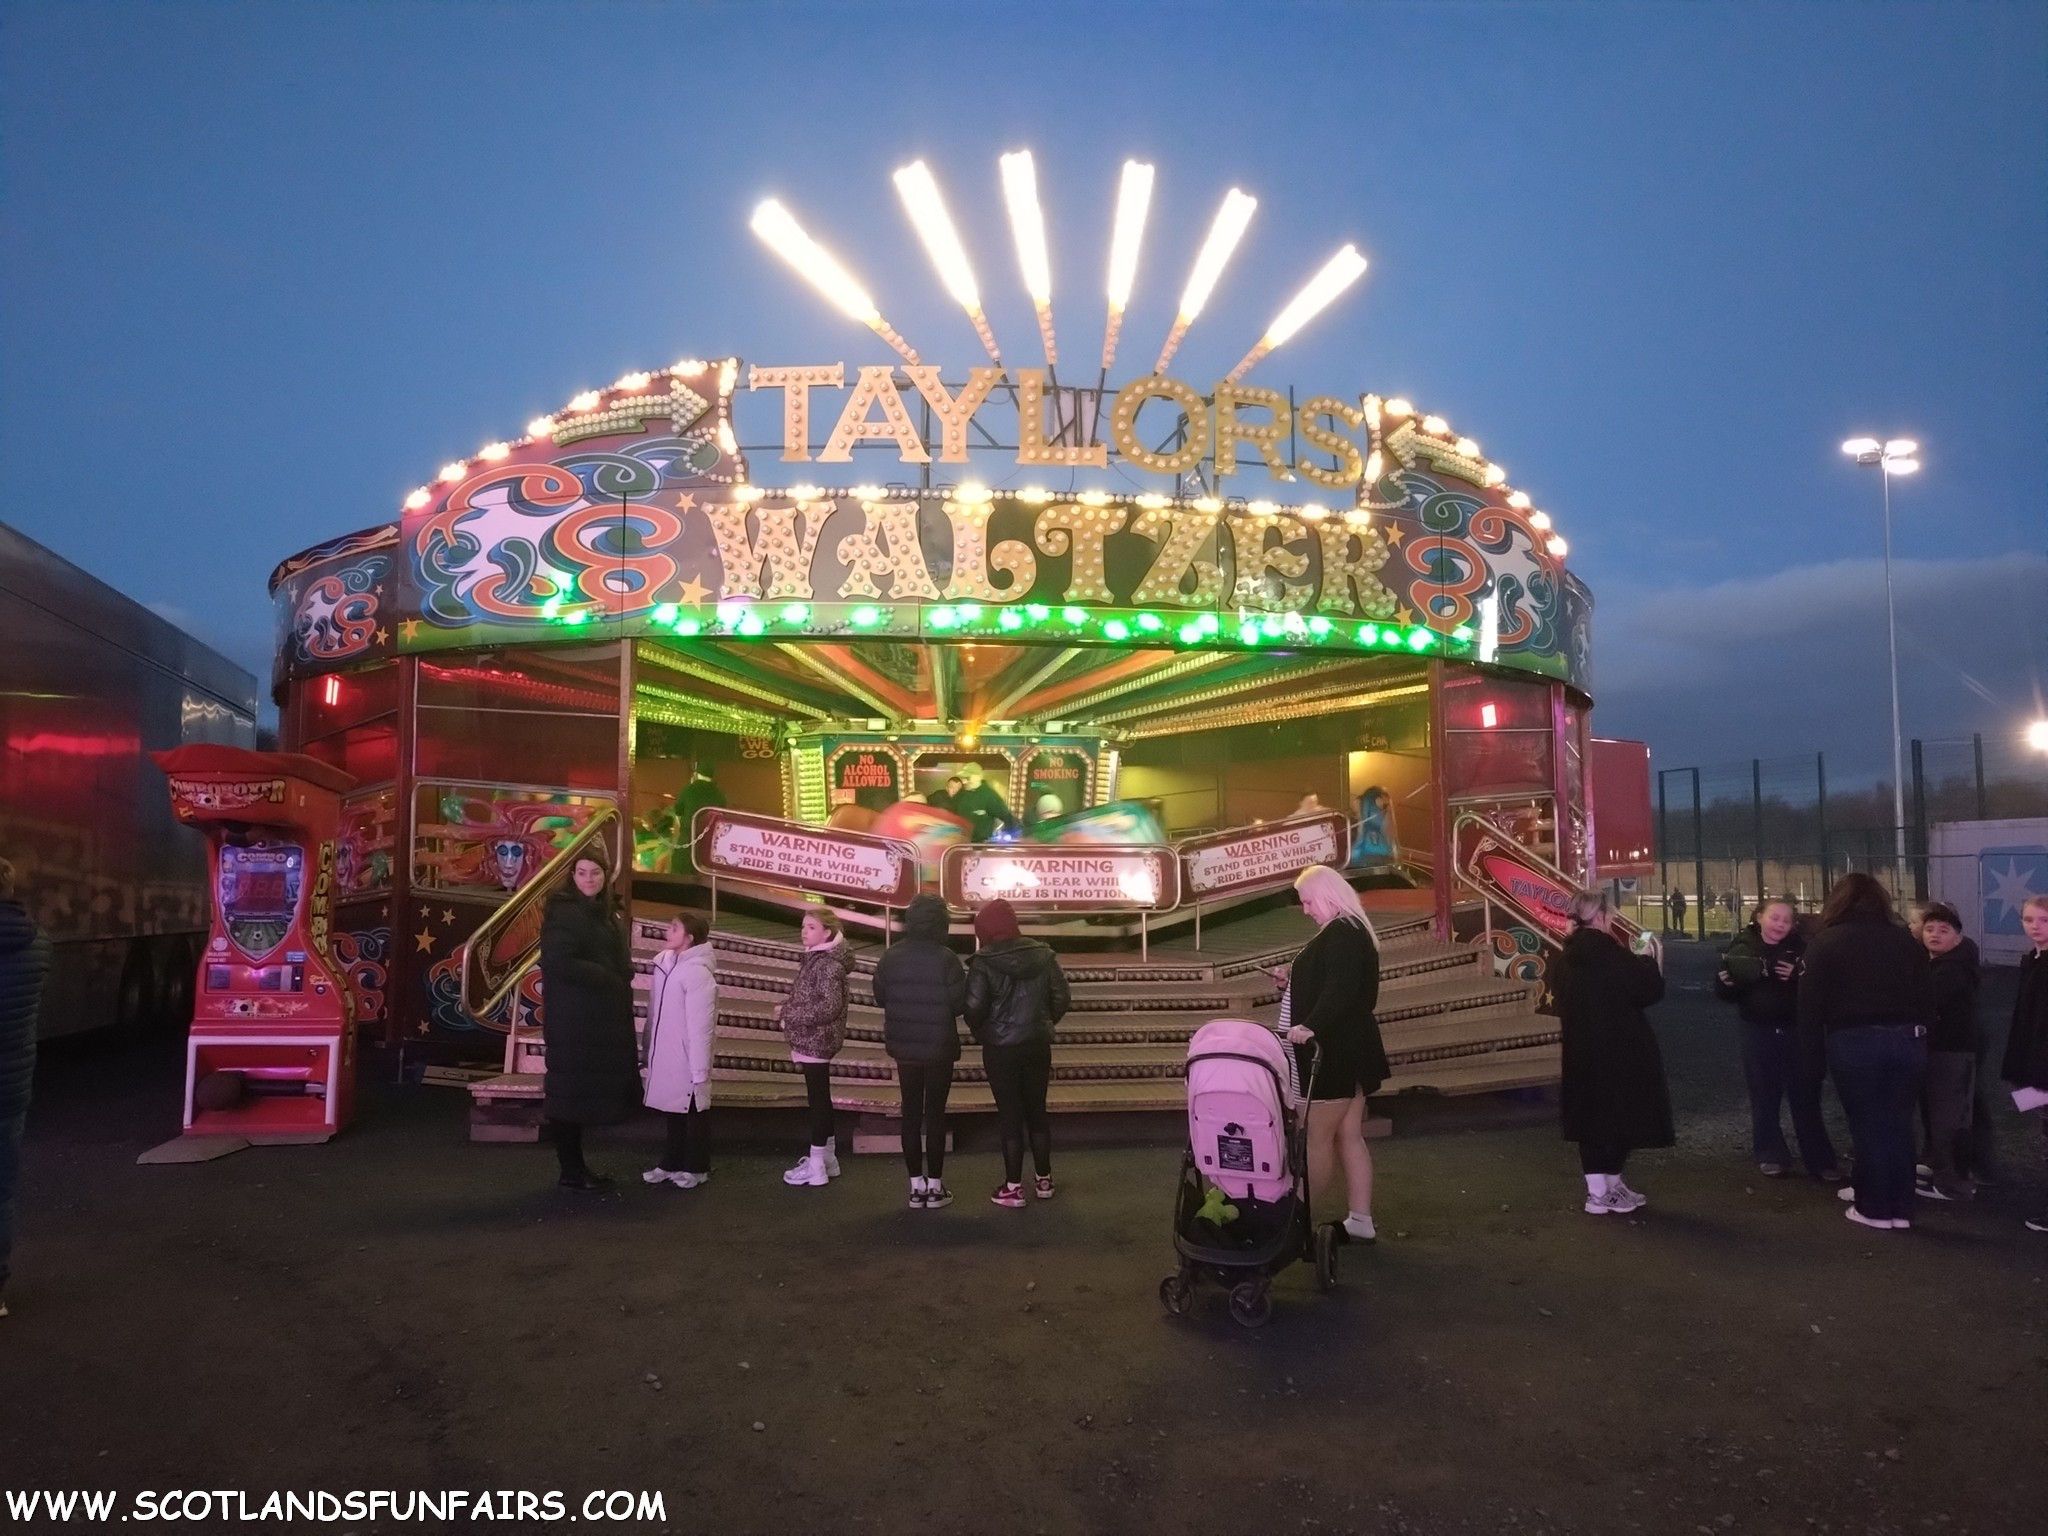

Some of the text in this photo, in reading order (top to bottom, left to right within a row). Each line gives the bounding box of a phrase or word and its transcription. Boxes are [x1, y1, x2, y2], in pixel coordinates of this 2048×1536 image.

[748, 364, 1365, 490] TAYLORS
[702, 500, 1398, 620] WALTZER
[747, 741, 769, 749] WE
[742, 750, 774, 759] GO
[859, 755, 874, 765] NO
[1049, 757, 1064, 768] NO
[843, 764, 889, 776] ALCOHOL
[1033, 768, 1080, 780] SMOKING
[842, 775, 891, 787] ALLOWED
[760, 832, 856, 859] WARNING
[1224, 833, 1300, 857] WARNING
[730, 843, 882, 877] STAND CLEAR WHILST
[1204, 842, 1323, 876] STAND CLEAR WHILST
[742, 857, 865, 886] RIDE IS IN MOTION
[1217, 856, 1314, 884] RIDE IS IN MOTION
[1086, 877, 1121, 887] WHIL
[999, 889, 1031, 899] RIDE
[1036, 889, 1049, 899] IS
[1053, 889, 1068, 899] IN
